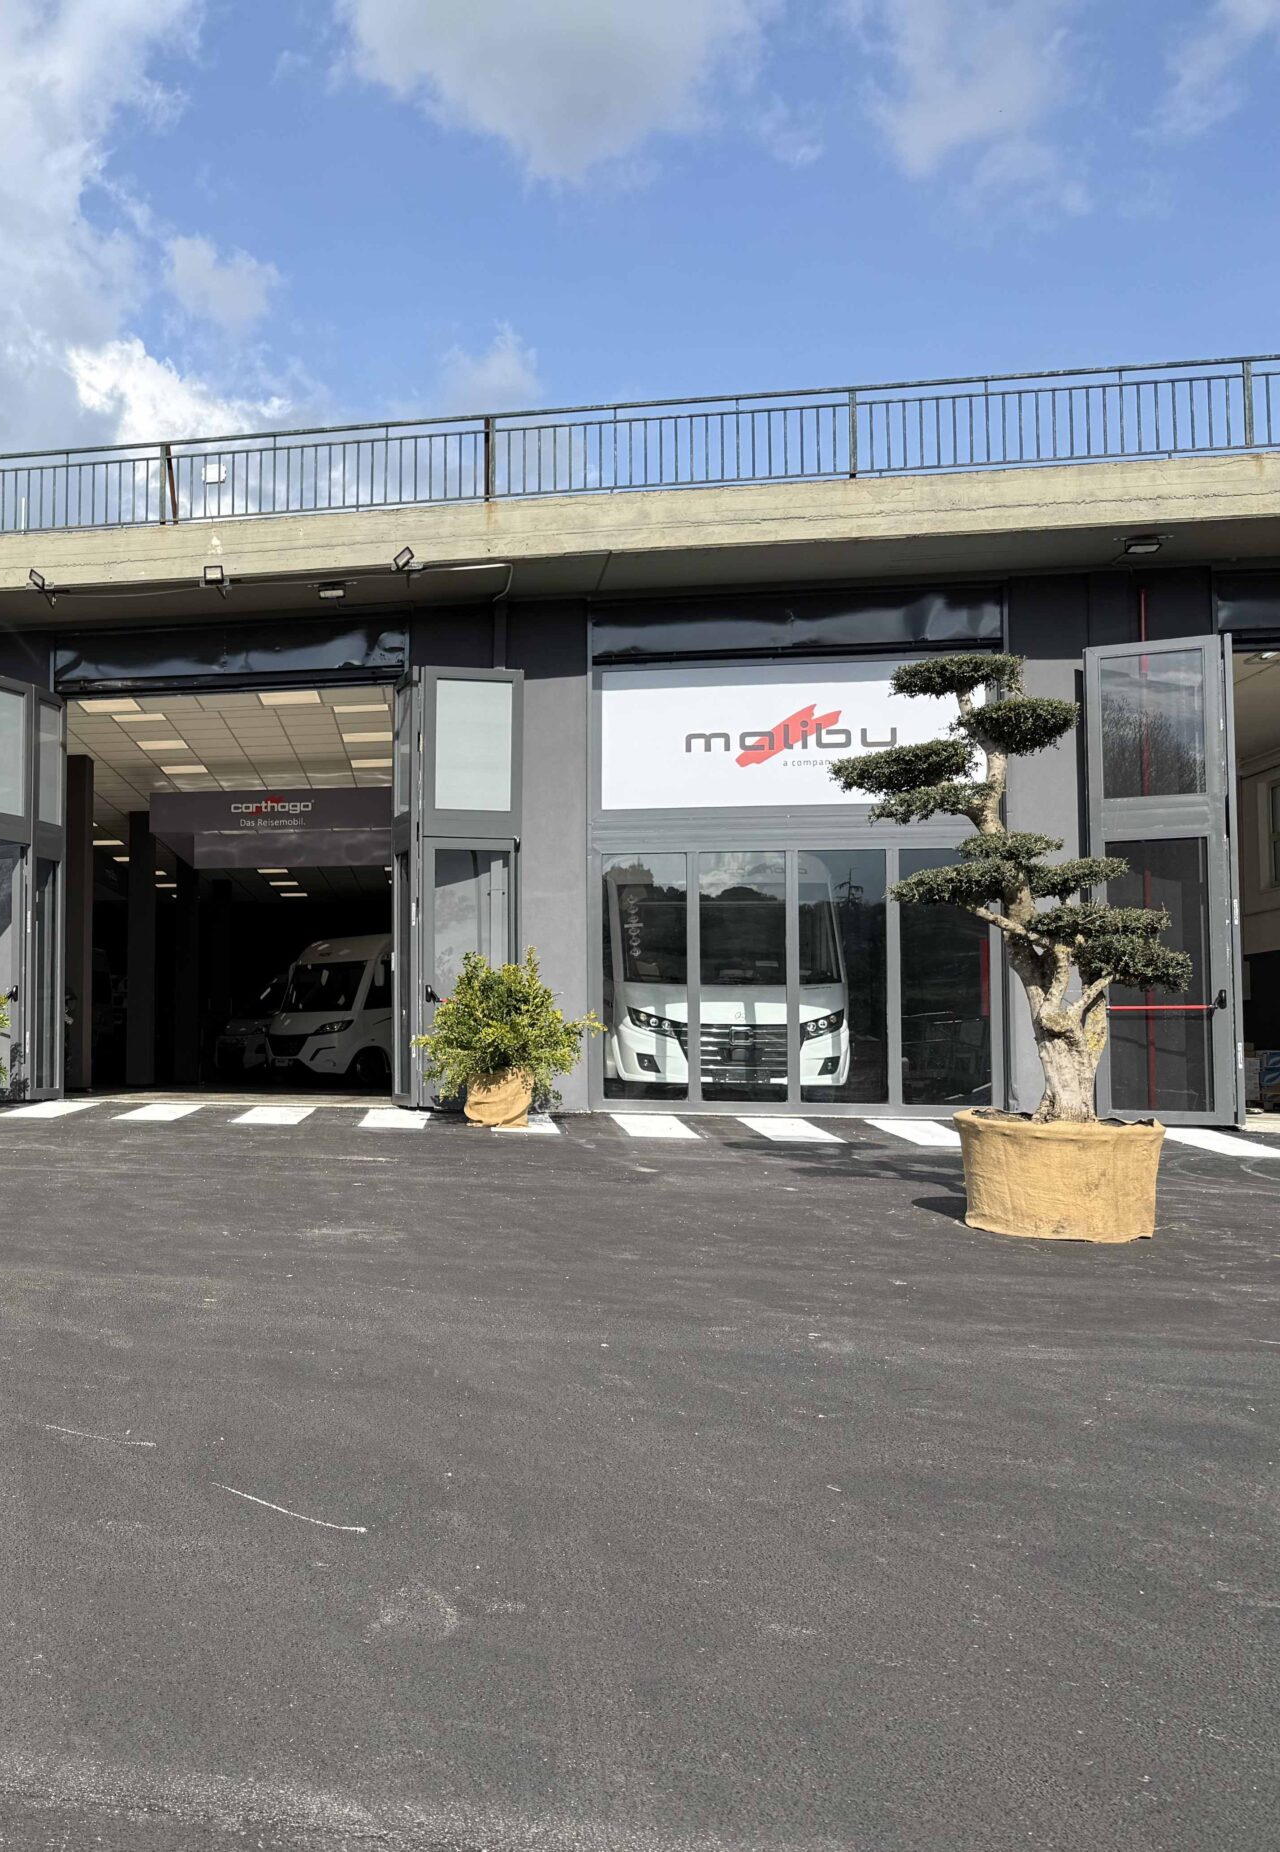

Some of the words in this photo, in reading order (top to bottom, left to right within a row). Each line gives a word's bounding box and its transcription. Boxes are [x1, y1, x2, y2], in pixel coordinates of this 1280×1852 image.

[685, 720, 897, 752] malibu
[231, 801, 312, 814] carthago
[240, 819, 255, 827] Das
